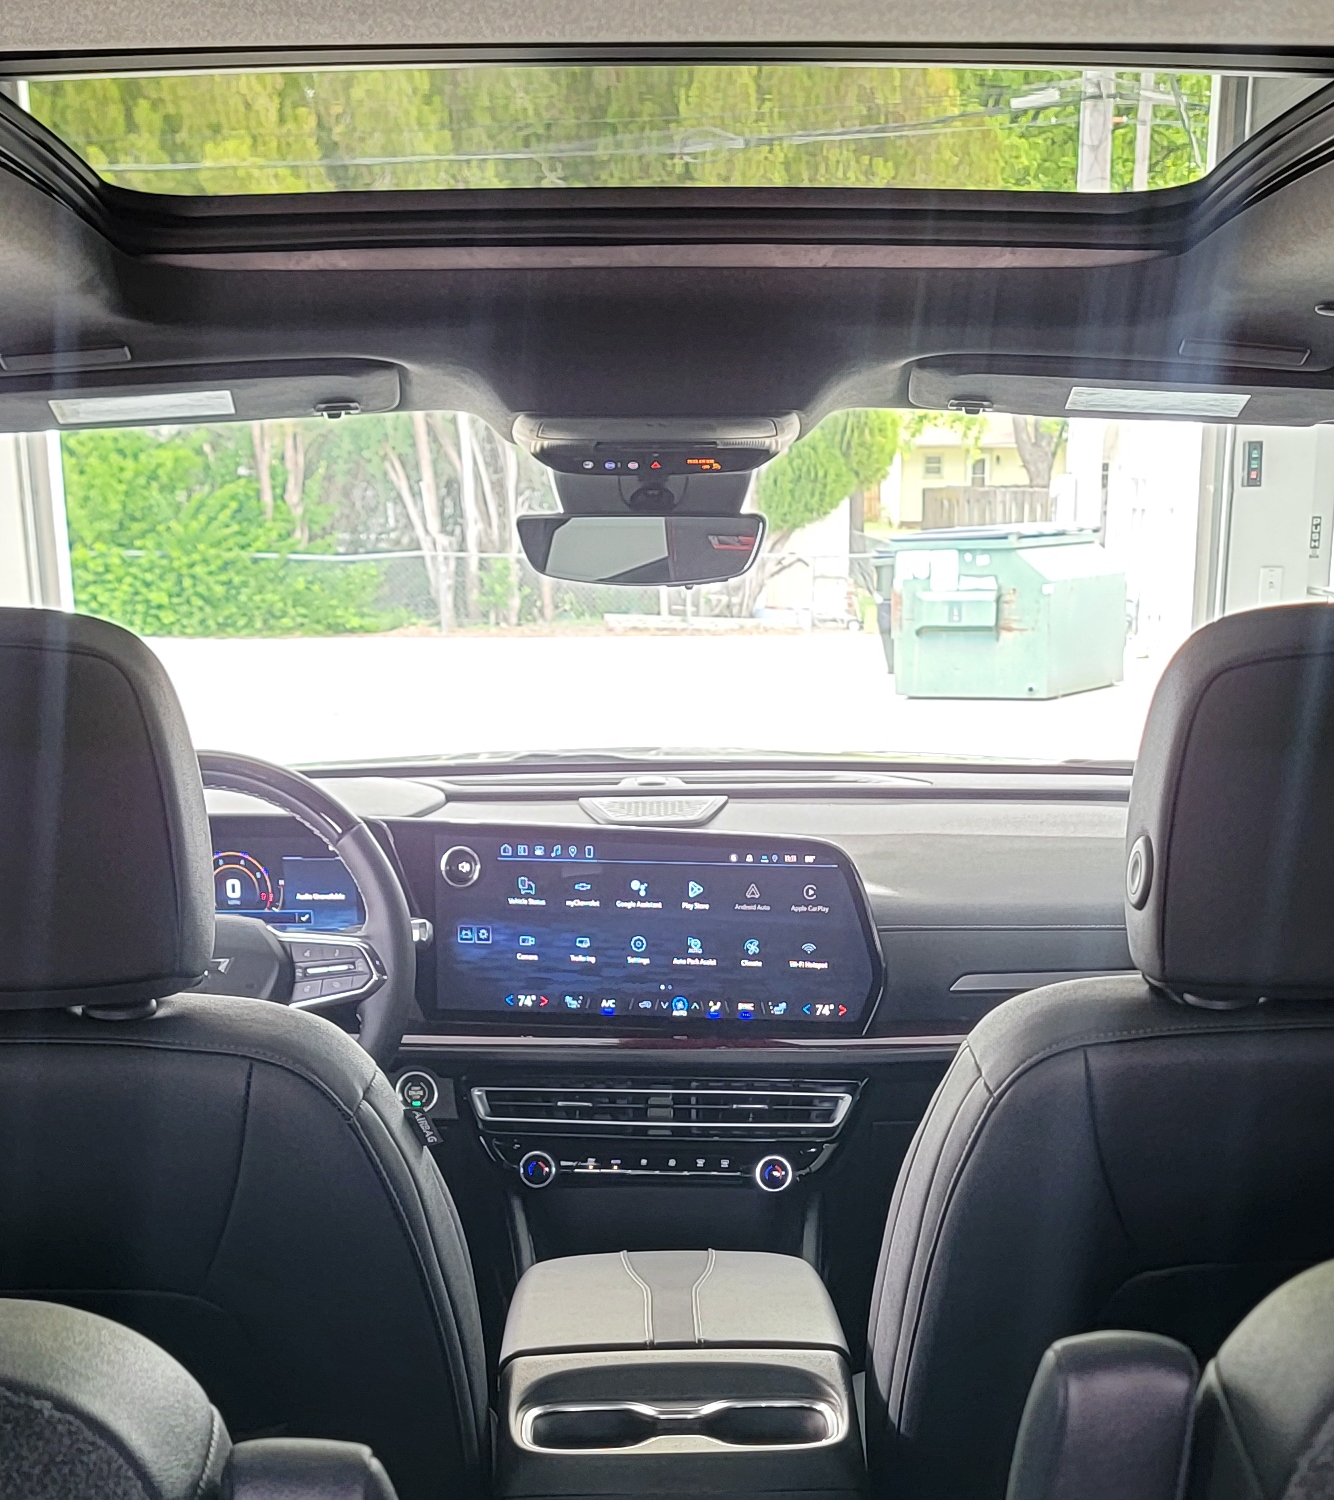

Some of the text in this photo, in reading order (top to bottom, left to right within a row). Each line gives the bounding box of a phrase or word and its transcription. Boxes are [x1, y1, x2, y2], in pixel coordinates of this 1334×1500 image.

[225, 878, 242, 899] 0
[734, 903, 756, 911] Android
[790, 904, 829, 914] Apple CarPlay
[412, 1110, 438, 1143] AIRBAG
